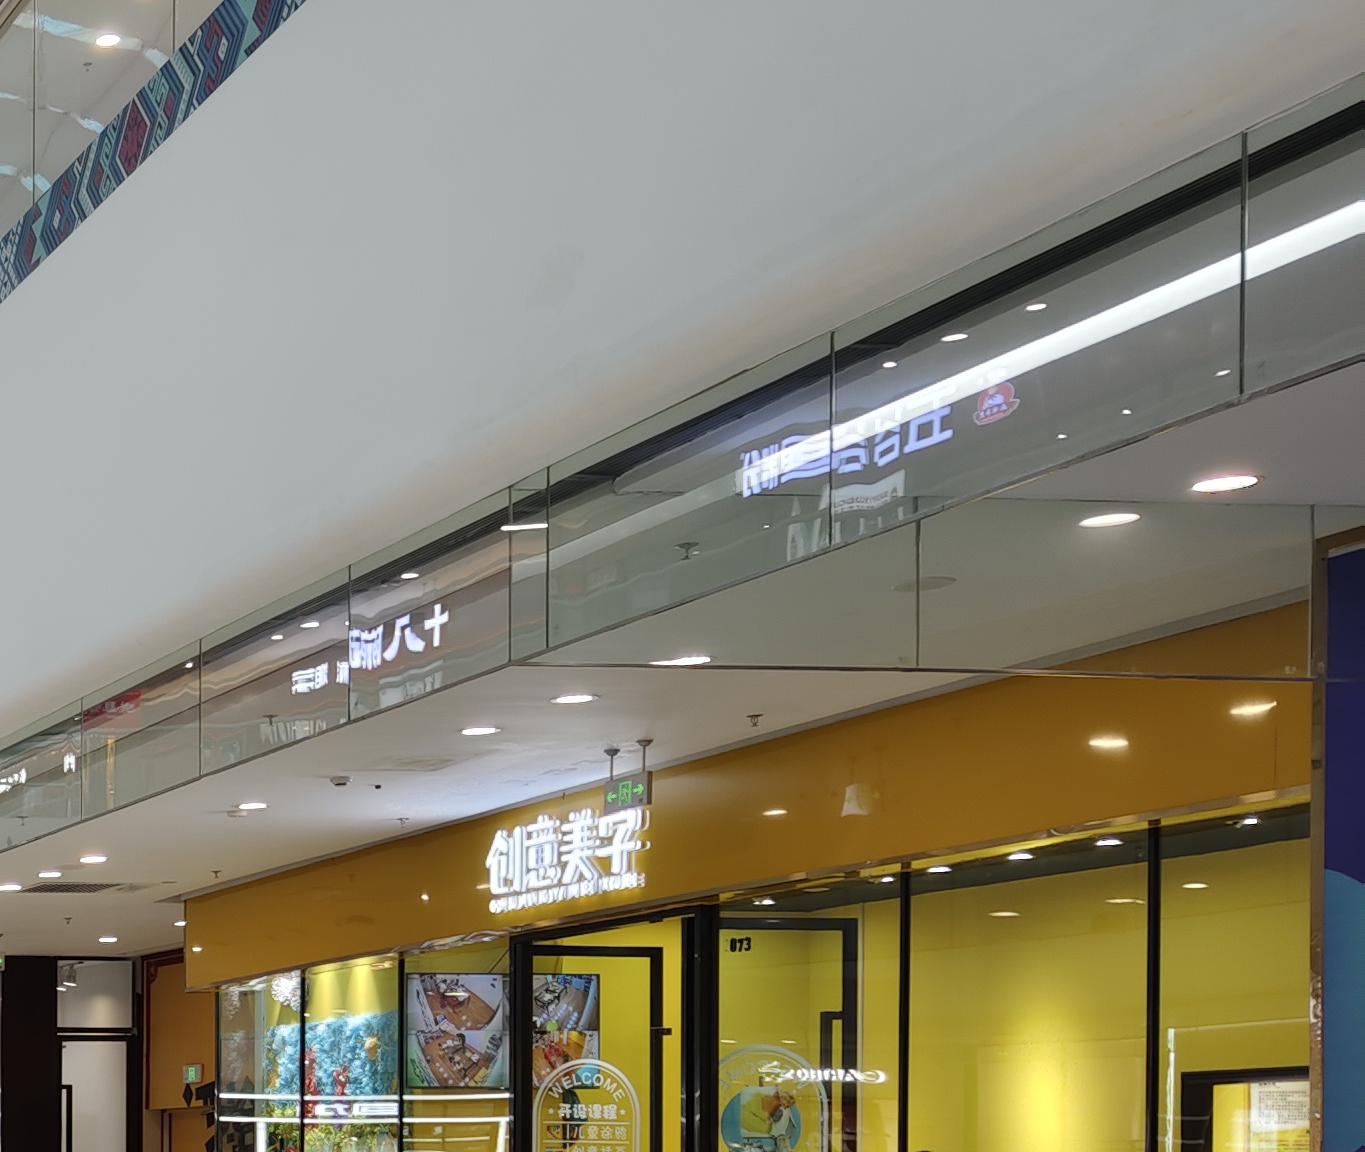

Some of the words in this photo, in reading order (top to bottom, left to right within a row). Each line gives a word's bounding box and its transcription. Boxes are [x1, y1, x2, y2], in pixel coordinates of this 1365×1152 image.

[548, 1072, 626, 1102] WELCOME
[558, 1103, 618, 1119] 开设课程
[572, 1125, 627, 1140] 儿童涂鸦
